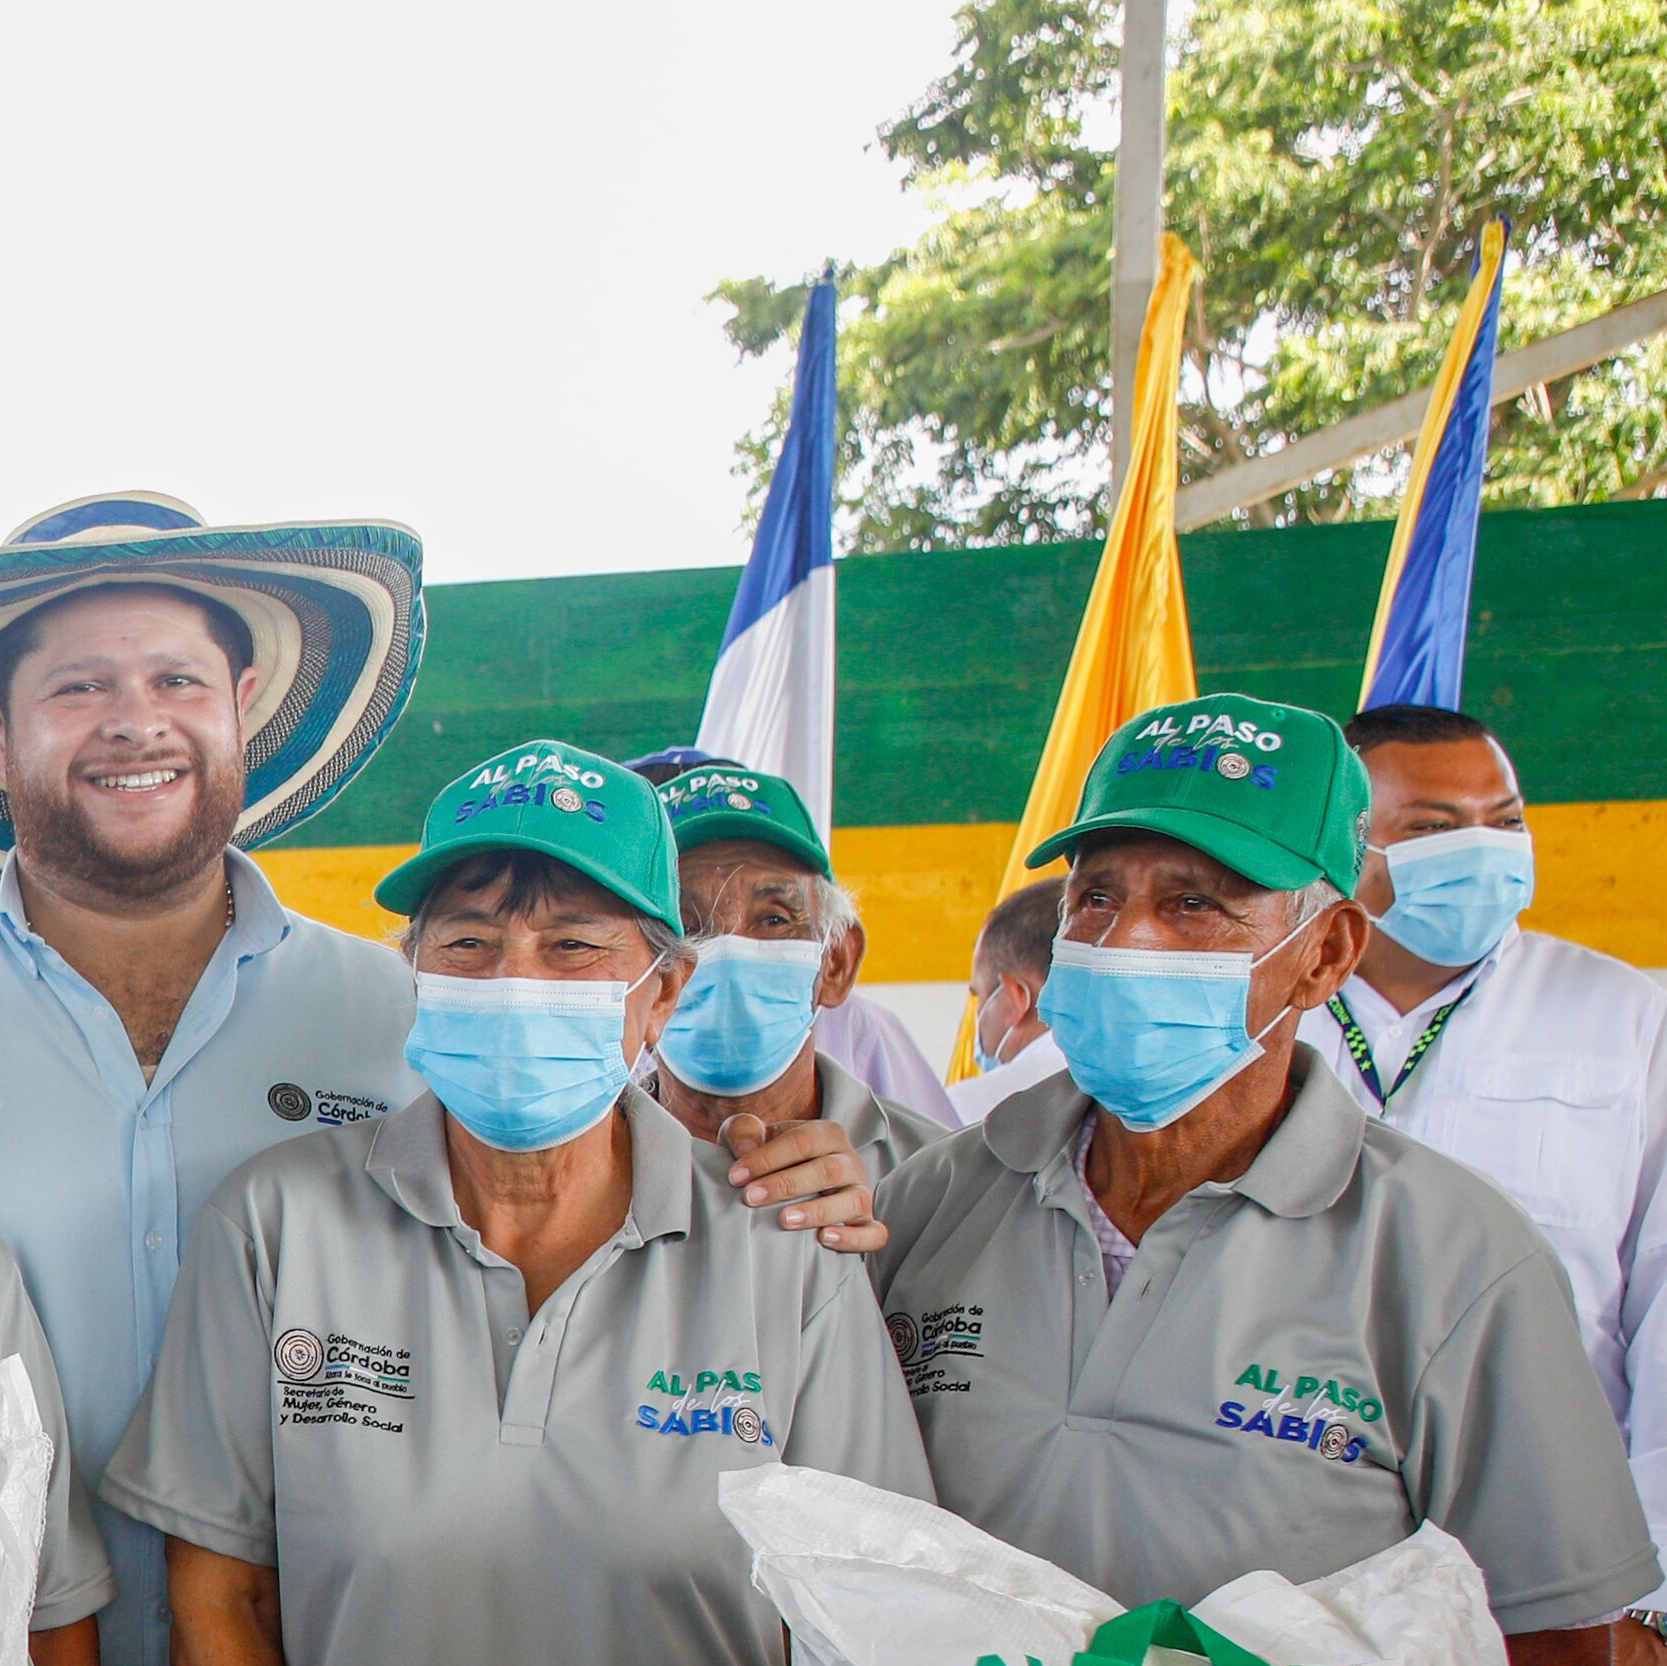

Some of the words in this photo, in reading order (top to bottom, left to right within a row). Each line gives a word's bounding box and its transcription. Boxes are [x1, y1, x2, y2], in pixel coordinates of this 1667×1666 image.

[1136, 717, 1180, 740] AL
[1186, 714, 1282, 751] PASO
[469, 765, 508, 789] AL
[515, 754, 604, 788] PASO
[327, 1334, 396, 1357] Gobernación
[397, 1349, 411, 1359] de
[327, 1347, 410, 1376] Córdoba
[647, 1370, 687, 1396] AL
[932, 1381, 971, 1392] Social
[1234, 1364, 1283, 1395] AL
[1293, 1376, 1383, 1422] PASO
[326, 1397, 377, 1414] Género
[280, 1414, 288, 1425] y
[292, 1413, 357, 1424] Desarrollo
[362, 1416, 403, 1432] Social
